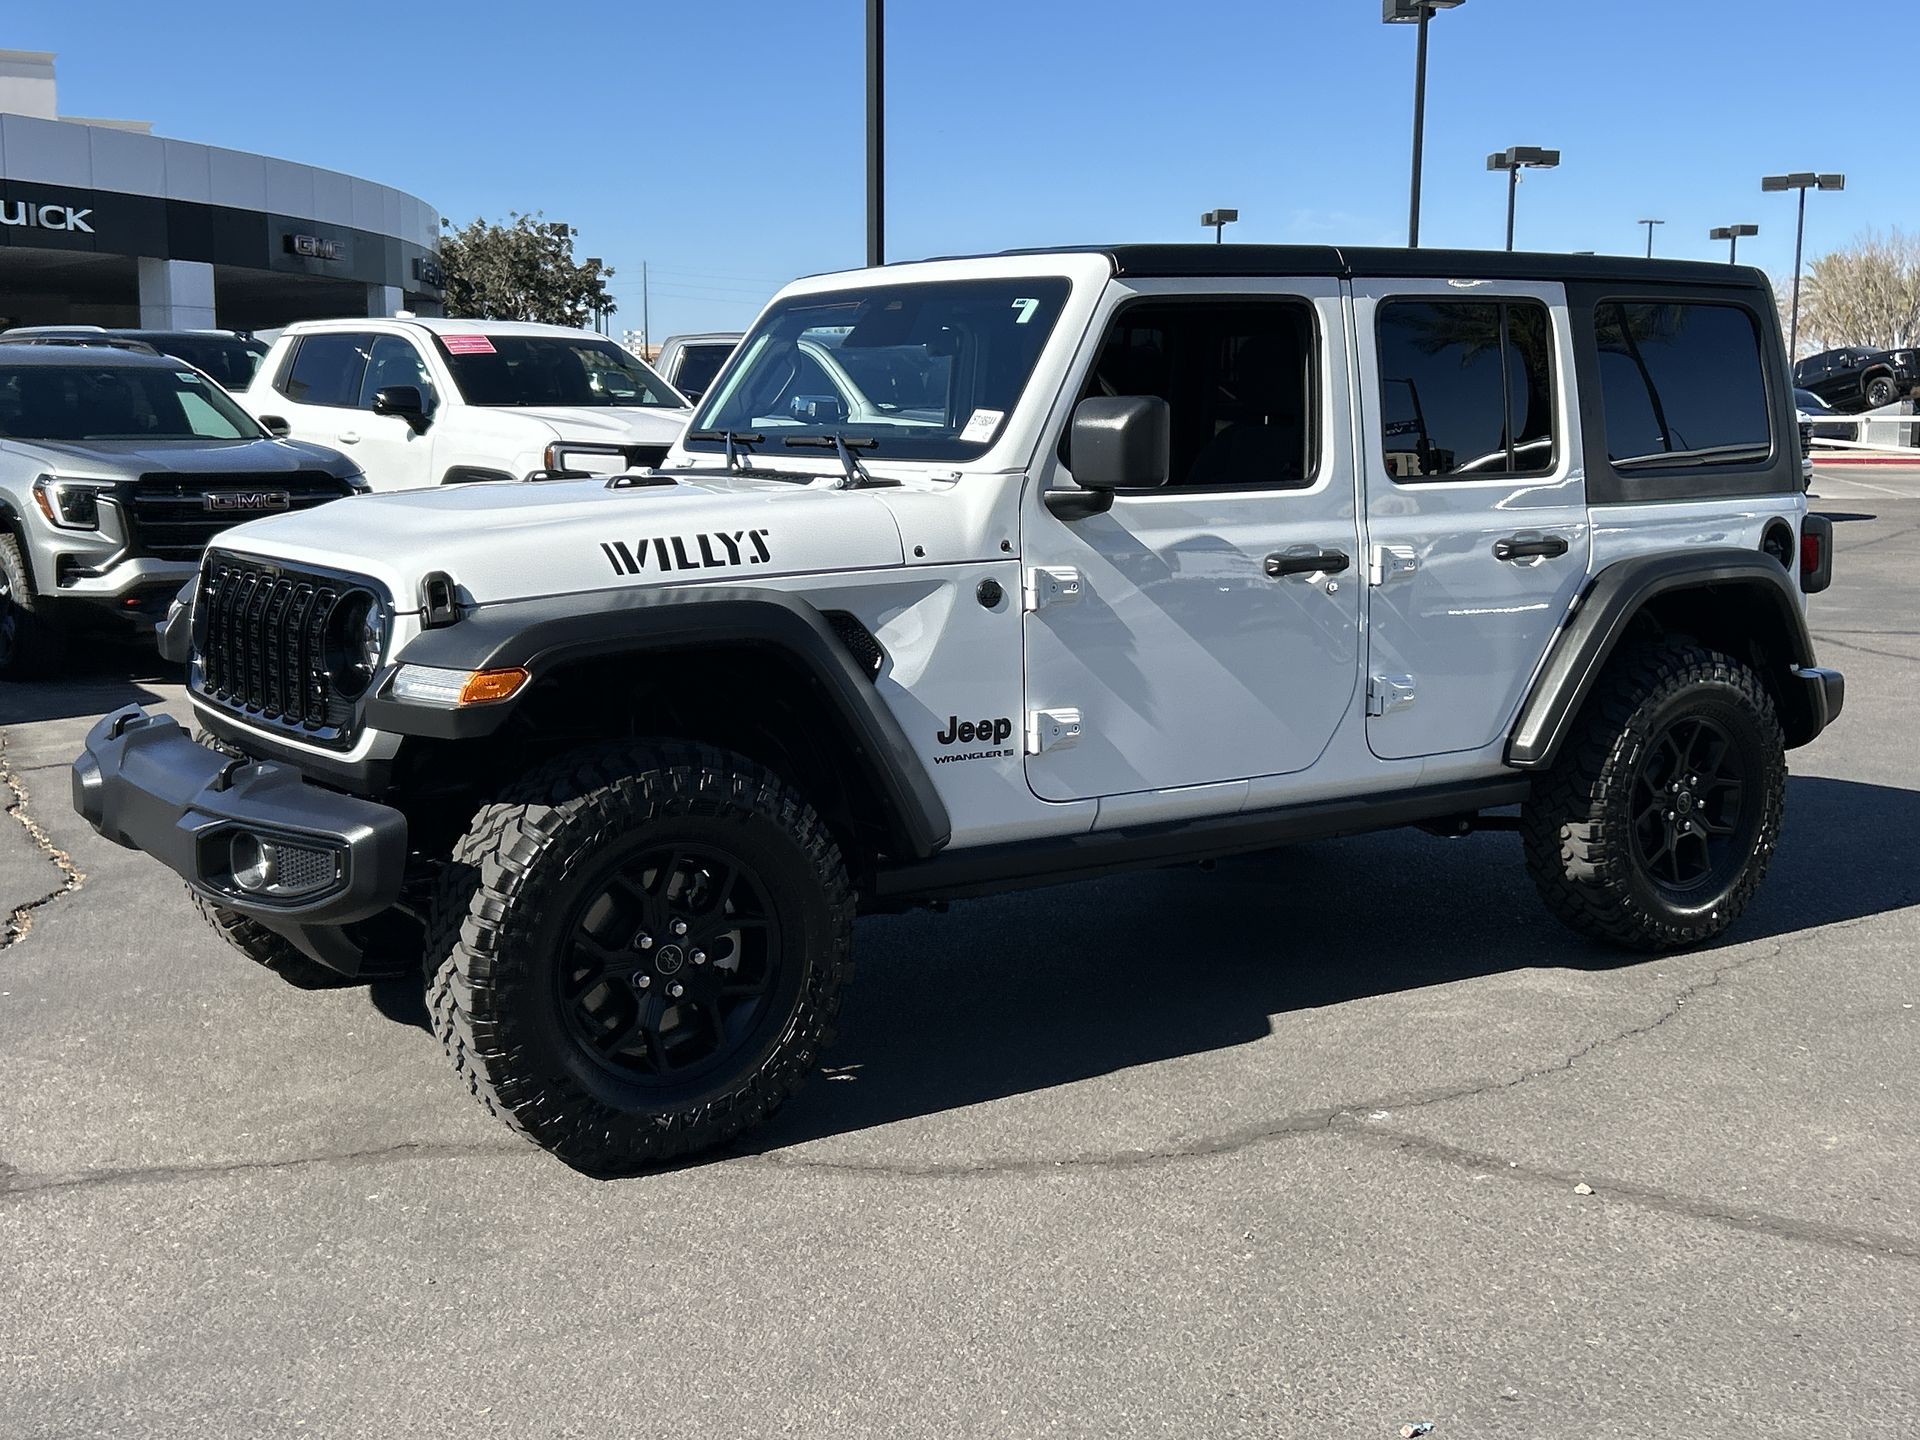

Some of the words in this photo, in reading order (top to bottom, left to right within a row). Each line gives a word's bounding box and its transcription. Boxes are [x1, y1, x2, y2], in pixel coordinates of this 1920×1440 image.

[294, 234, 345, 261] GMC
[206, 492, 289, 510] GMC
[600, 529, 771, 575] WILLYS
[937, 715, 1012, 745] Jeep
[933, 750, 1002, 765] WRANGLER
